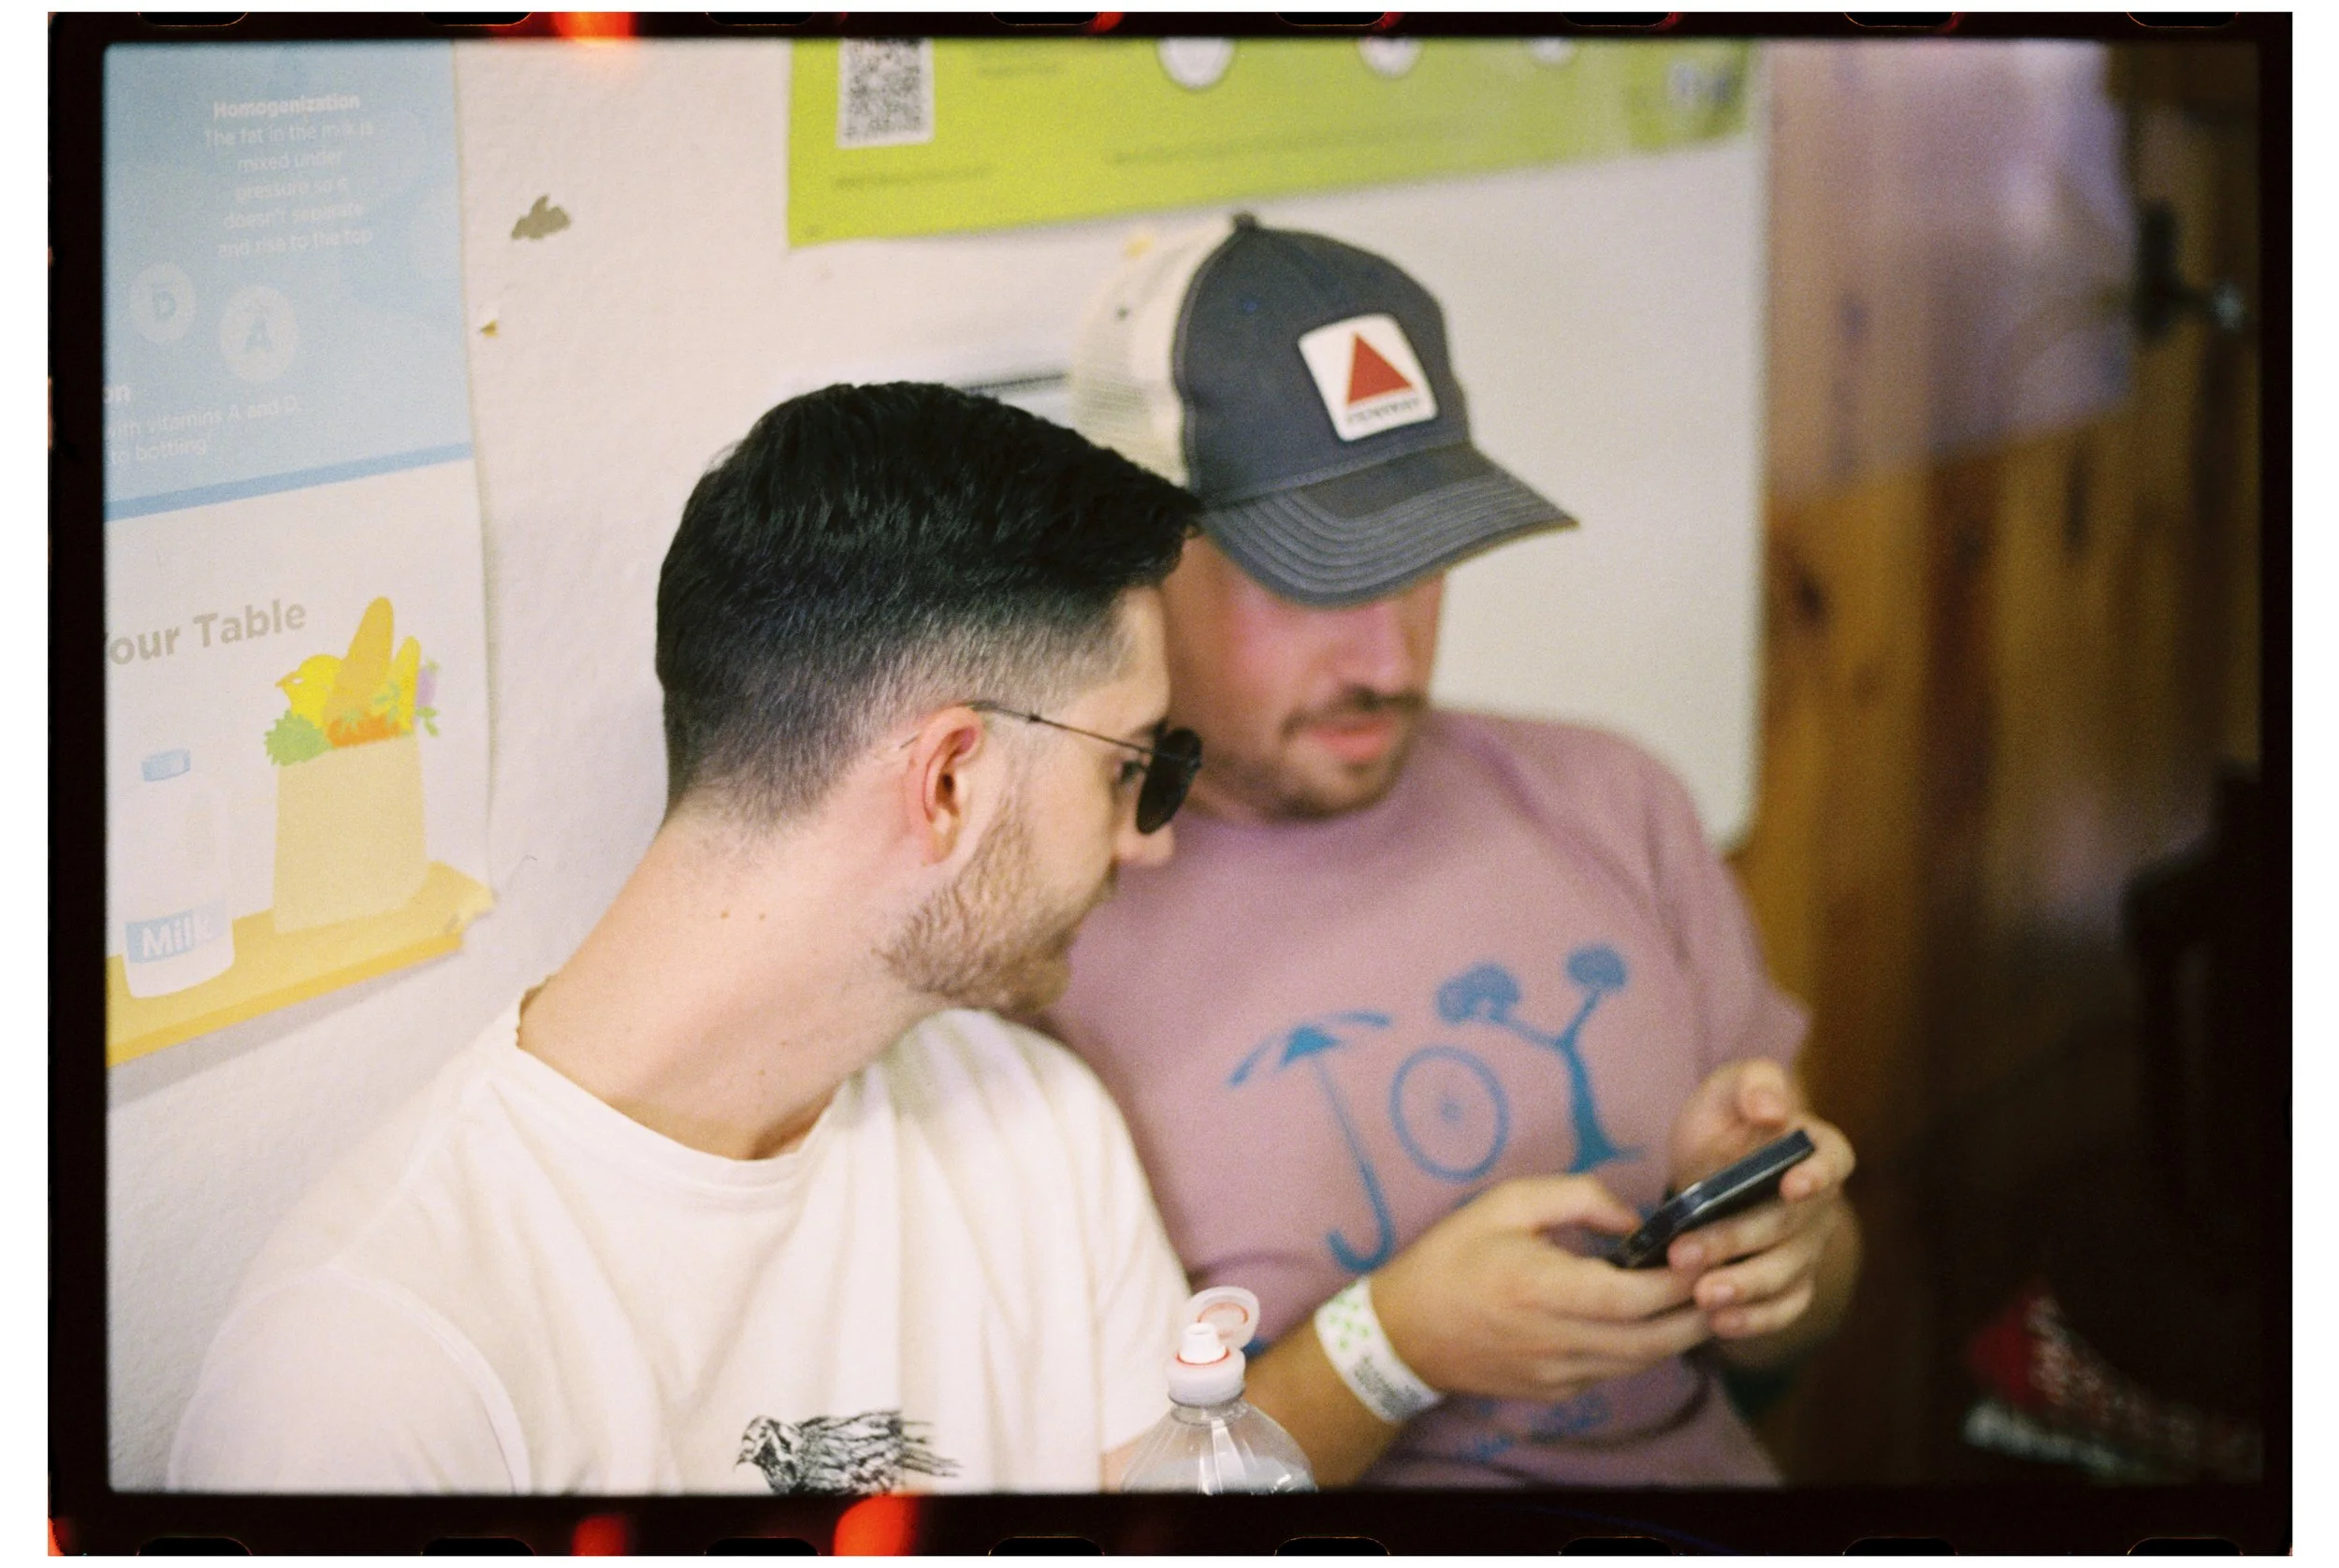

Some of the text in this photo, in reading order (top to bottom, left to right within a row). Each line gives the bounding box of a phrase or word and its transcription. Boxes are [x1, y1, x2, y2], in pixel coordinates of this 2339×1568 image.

[213, 94, 360, 119] Homogenization
[205, 128, 236, 147] The
[240, 127, 264, 143] fat
[289, 123, 316, 141] the
[238, 150, 342, 172] mixed under
[235, 181, 309, 203] pressure
[218, 240, 250, 257] and
[243, 314, 274, 355] A
[146, 410, 223, 433] vitamins
[227, 403, 242, 421] A
[247, 399, 279, 418] and
[108, 598, 307, 665] our Table
[141, 914, 213, 959] Milk
